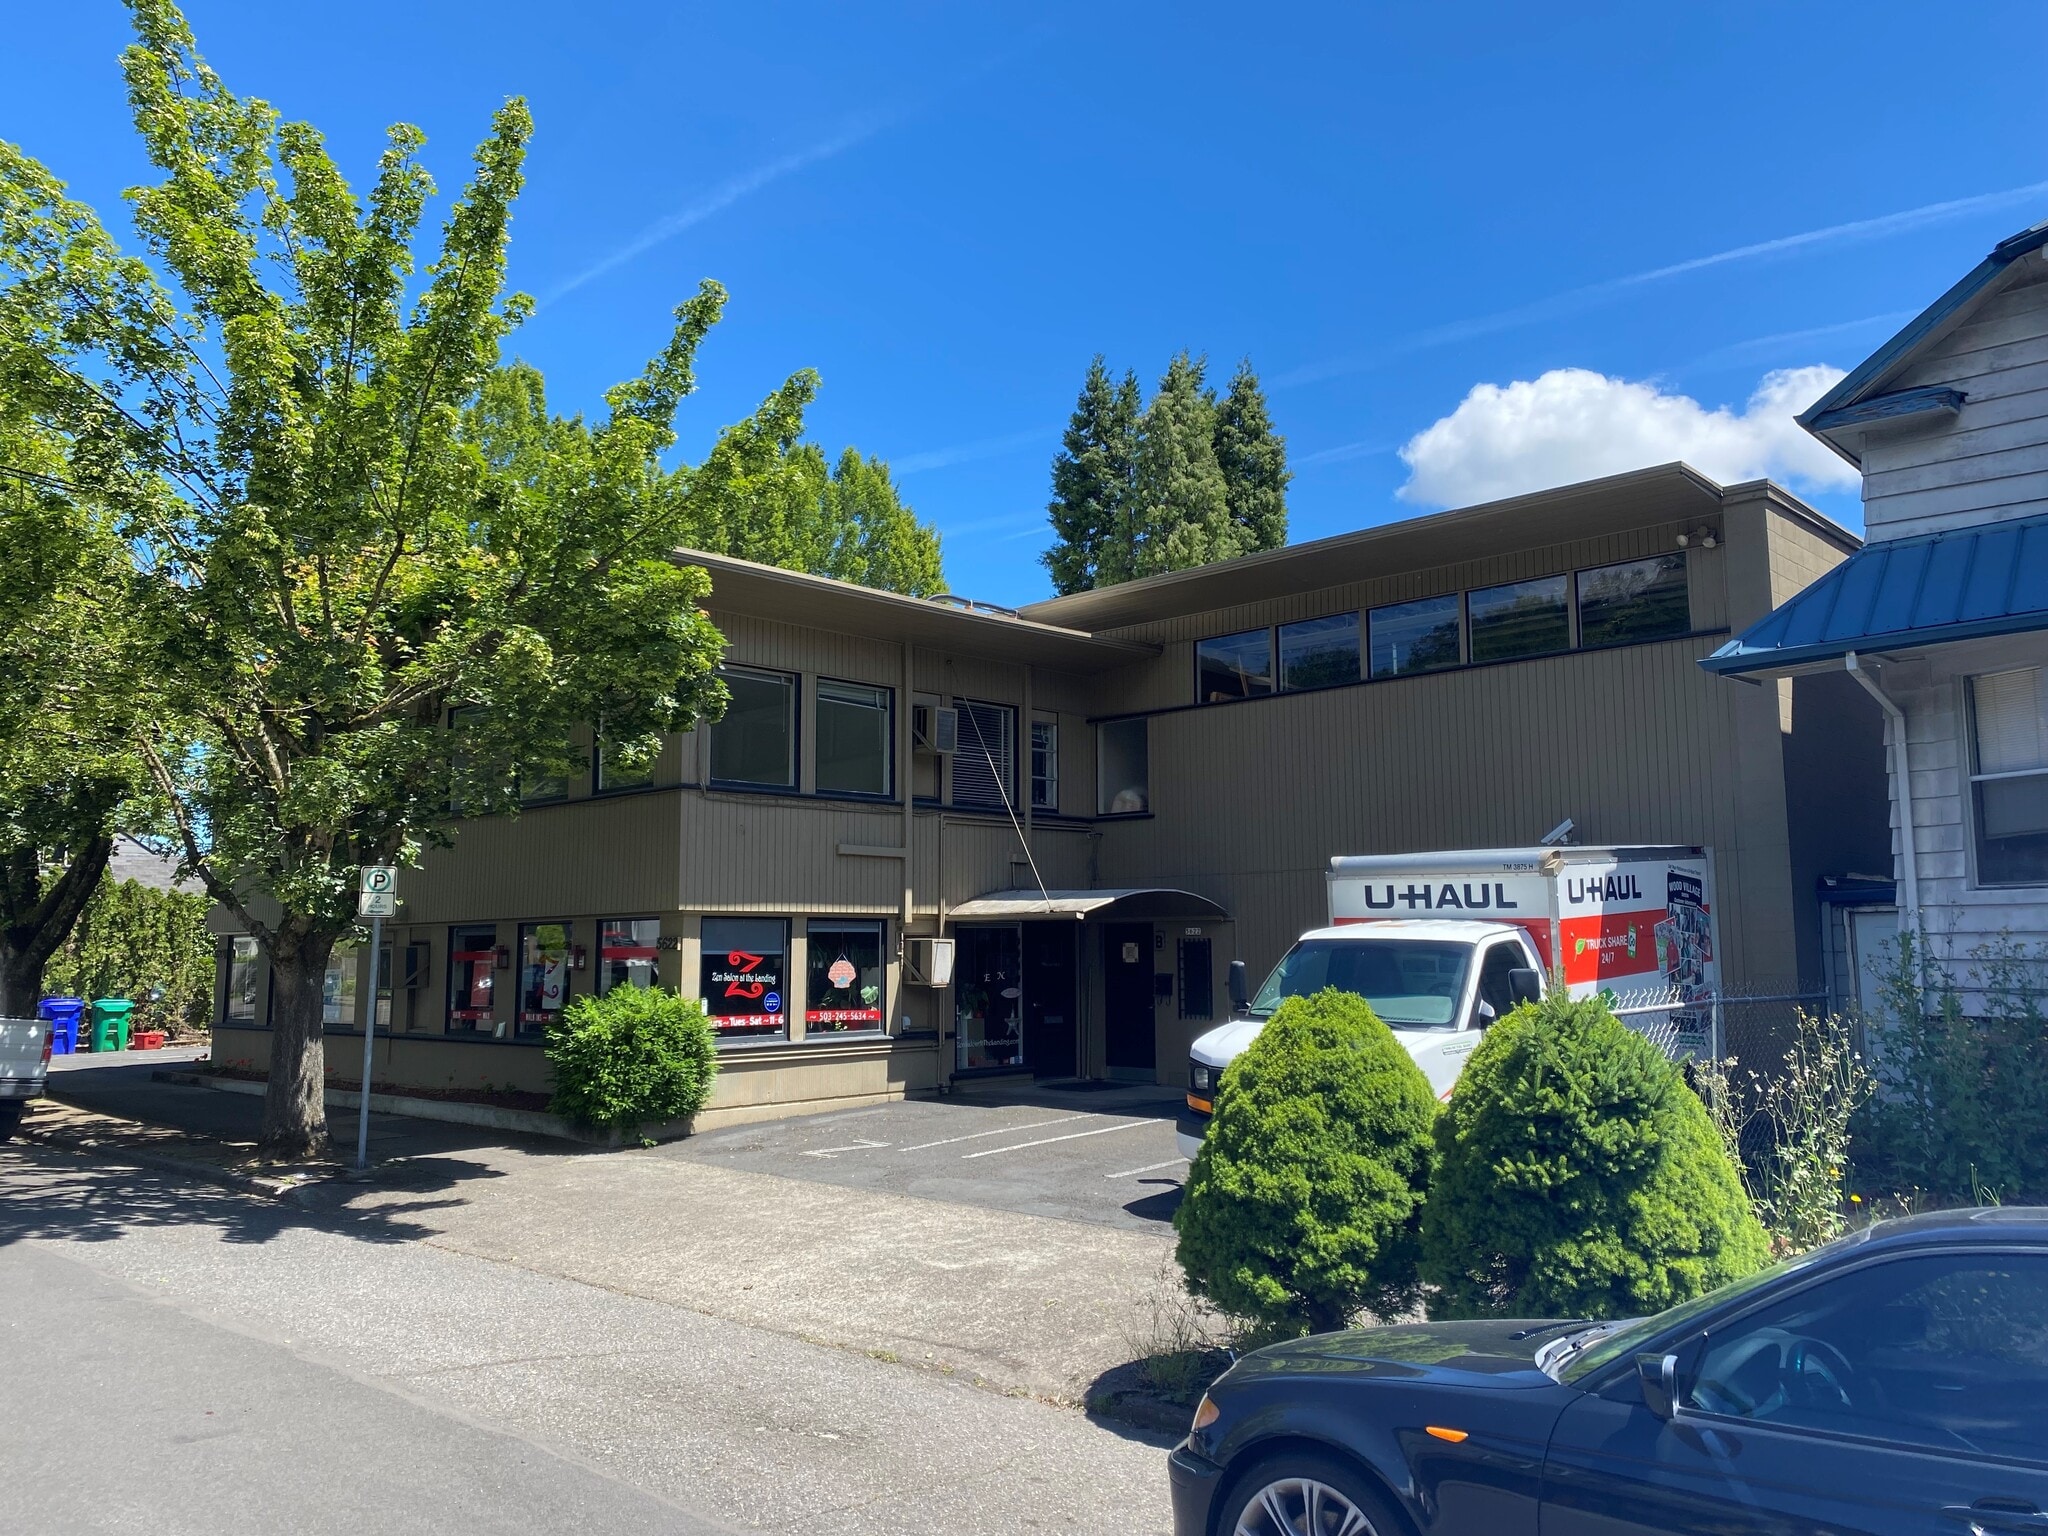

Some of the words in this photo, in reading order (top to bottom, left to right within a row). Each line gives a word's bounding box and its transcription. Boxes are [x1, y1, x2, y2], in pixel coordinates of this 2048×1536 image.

[1502, 863, 1512, 871] TM
[1513, 863, 1528, 871] 3875
[1528, 863, 1534, 871] H
[374, 874, 386, 887] P
[1364, 882, 1518, 909] U-HAUL
[1568, 875, 1641, 904] U-HAUL
[1668, 881, 1683, 892] WOOD
[1683, 882, 1702, 898] VILLAGE
[375, 895, 382, 903] 2
[656, 936, 678, 950] 5622
[1586, 937, 1607, 950] TRUCK
[1607, 934, 1628, 948] SHARE
[1601, 952, 1615, 964] 24/7
[711, 971, 723, 982] Zen
[723, 972, 739, 982] Salon
[739, 973, 746, 982] at
[745, 973, 755, 983] the
[754, 973, 776, 985] Landing
[819, 1011, 867, 1021] 503-245-5634
